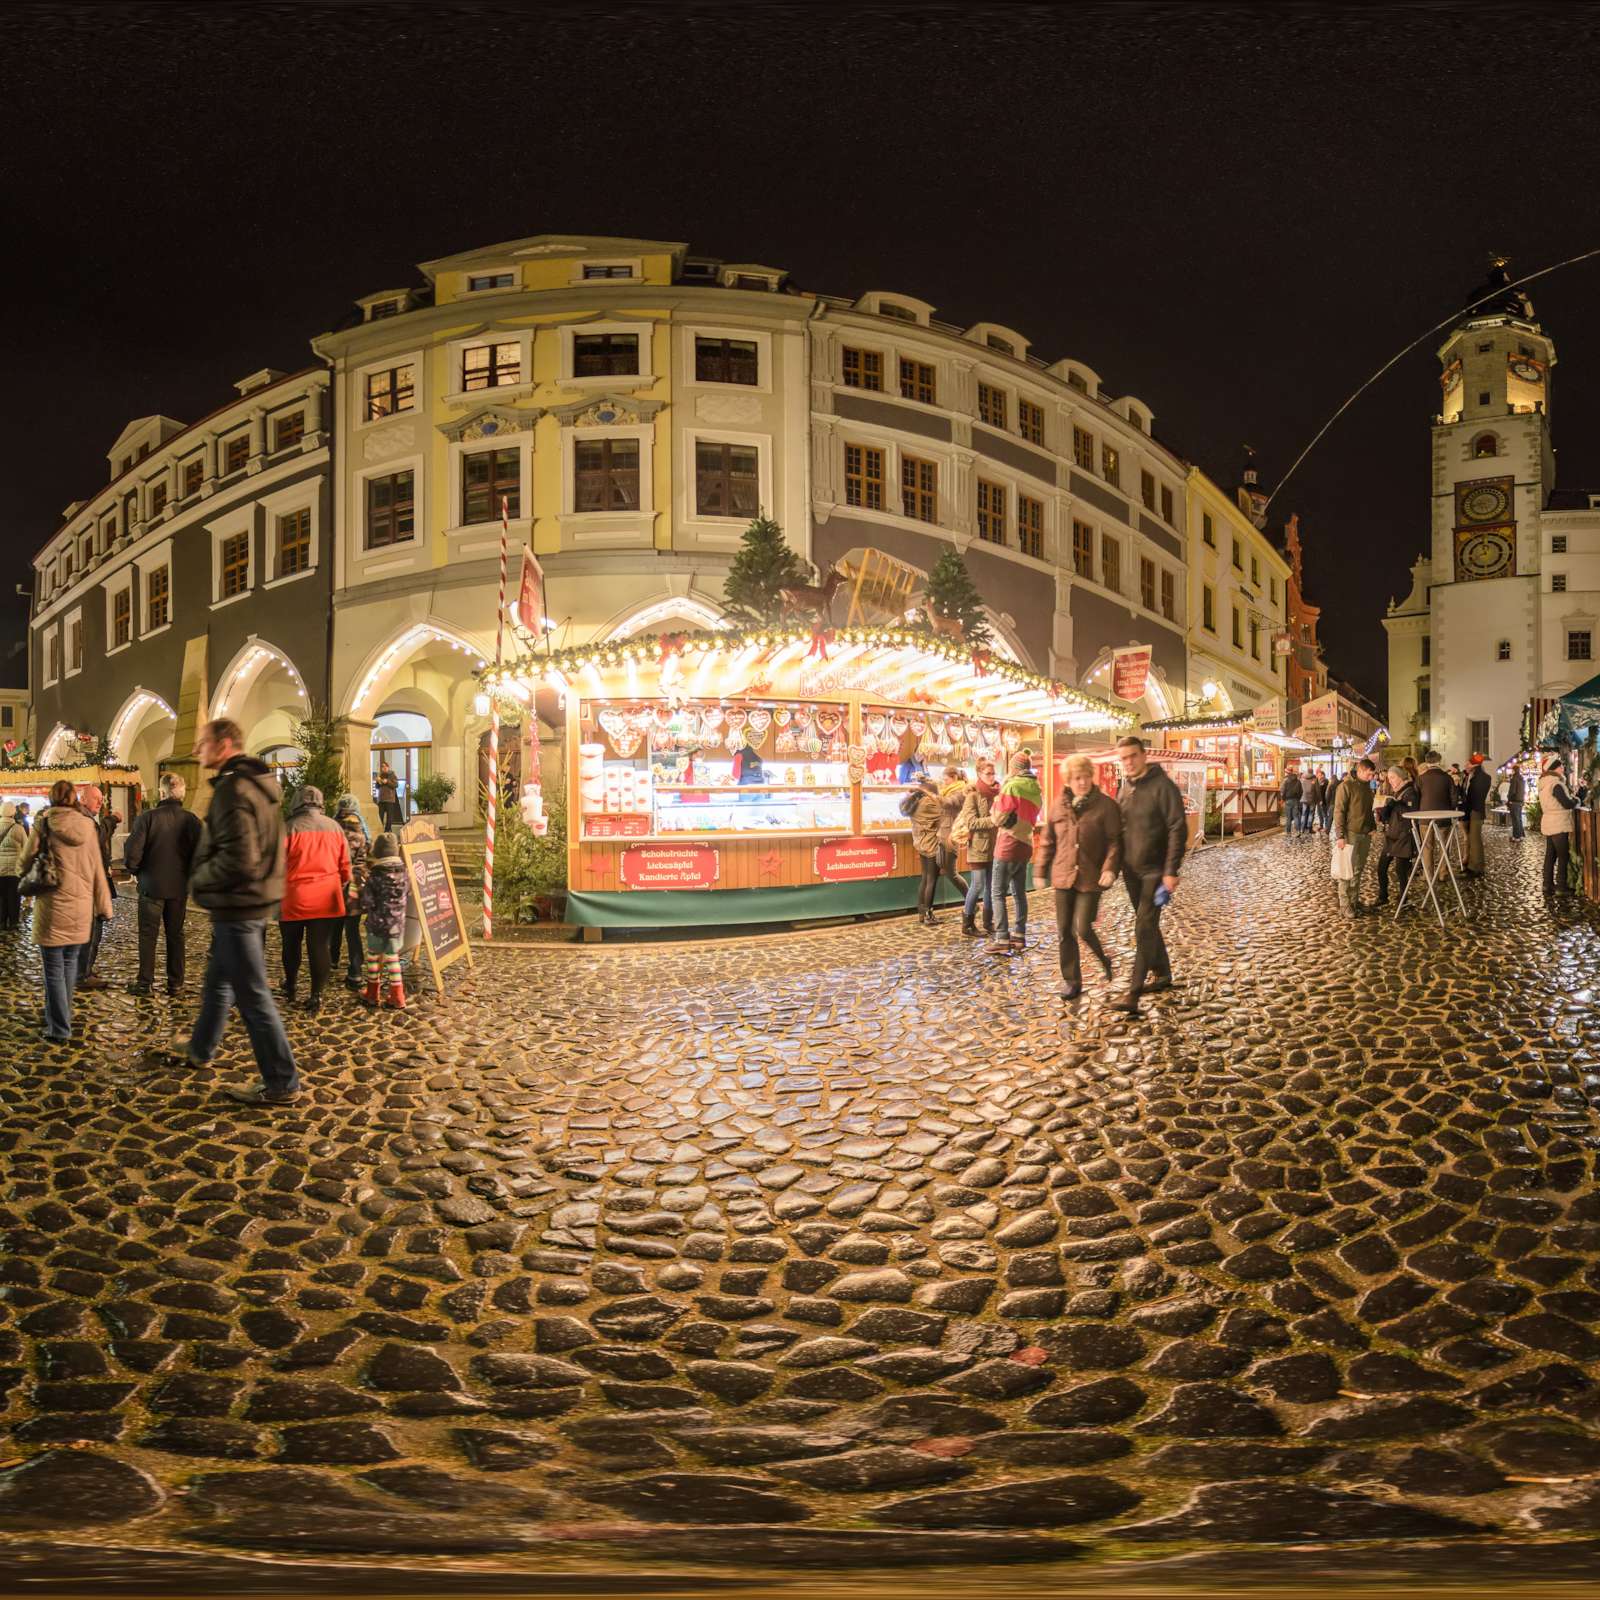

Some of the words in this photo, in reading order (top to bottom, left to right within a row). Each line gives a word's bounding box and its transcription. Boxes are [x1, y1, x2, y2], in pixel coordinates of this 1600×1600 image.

[835, 848, 878, 857] Zuckerwatte
[826, 861, 887, 871] Lebkuchenherzen
[639, 872, 679, 881] Kandierte
